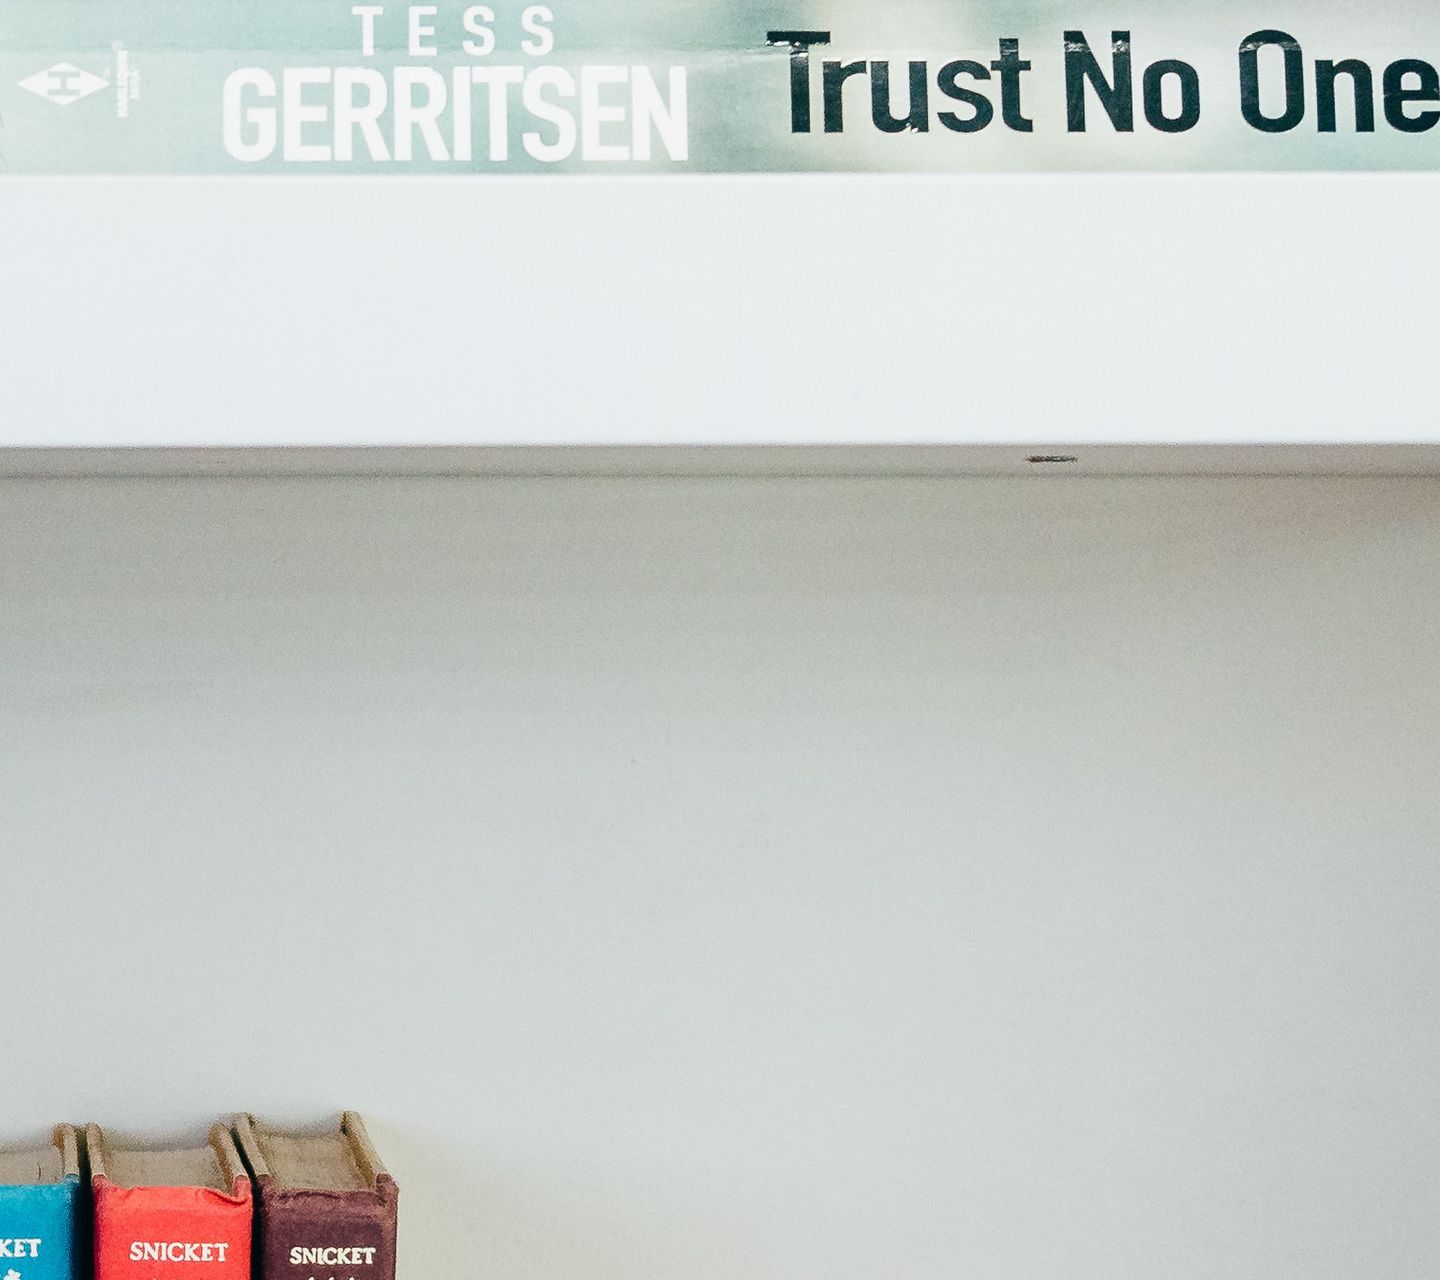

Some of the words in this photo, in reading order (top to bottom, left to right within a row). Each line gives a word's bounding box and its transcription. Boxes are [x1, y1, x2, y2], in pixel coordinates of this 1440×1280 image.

[352, 4, 555, 57] TESS
[766, 29, 1034, 134] Trust
[1063, 29, 1201, 134] No
[1239, 28, 1440, 134] One
[222, 66, 690, 163] GERRITSEN
[129, 1241, 228, 1262] SNICKET
[289, 1246, 376, 1266] SNICKET
